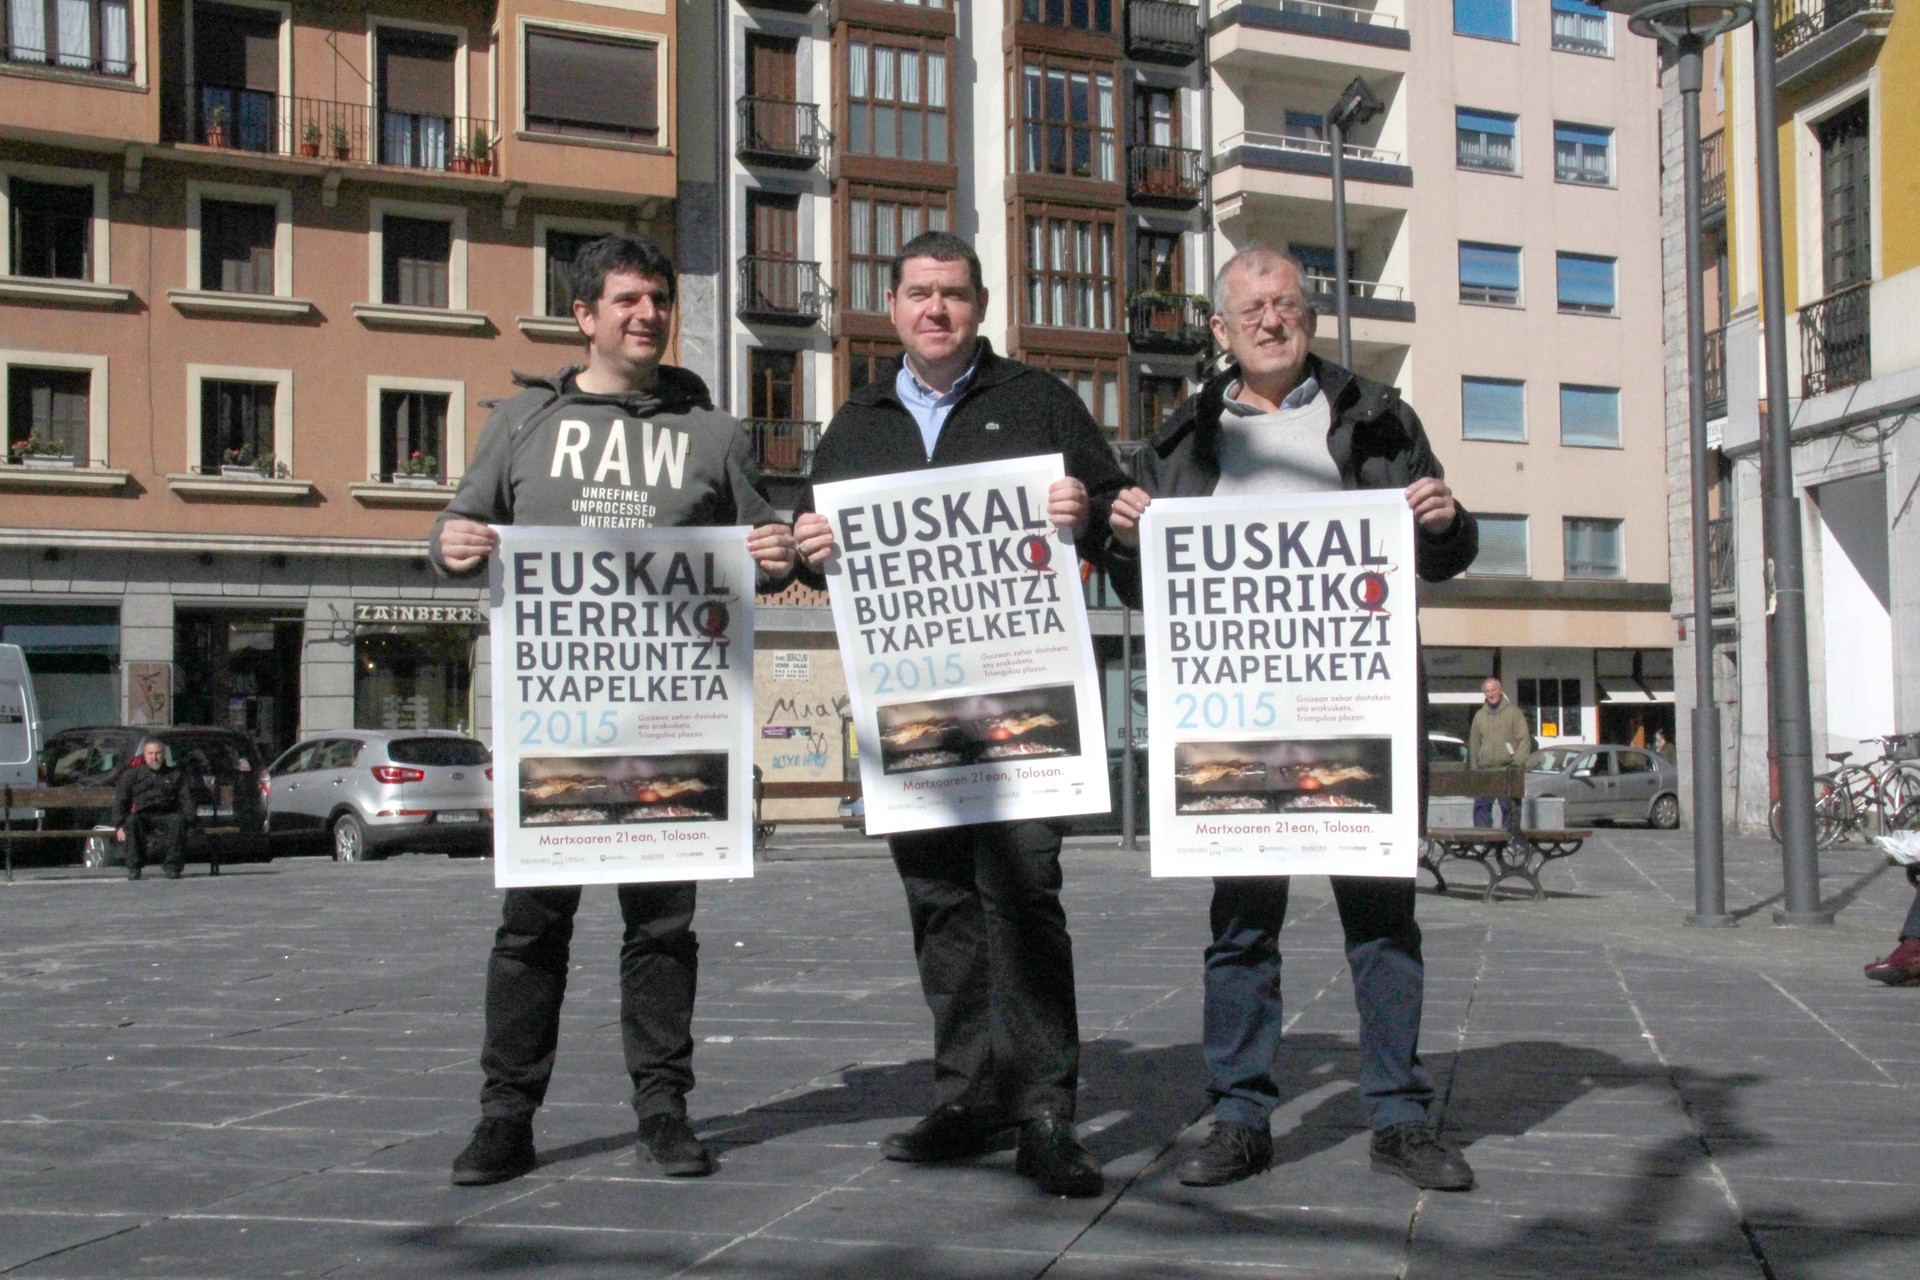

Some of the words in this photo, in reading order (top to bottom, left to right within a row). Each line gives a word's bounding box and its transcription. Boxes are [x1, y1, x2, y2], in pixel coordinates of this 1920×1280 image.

[550, 419, 689, 490] RAW
[572, 499, 656, 517] UNPROCESSED
[582, 487, 648, 502] UNREFINED
[838, 486, 1047, 552] EUSKAL
[1165, 518, 1388, 572] EUSKAL
[514, 551, 730, 596] EUSKAL
[847, 534, 1052, 592] HERRIKO
[855, 574, 1061, 625] BURRUNTZI
[1168, 571, 1389, 615] HERRIKO
[515, 600, 730, 638] HERRIKO
[861, 607, 1065, 655] TXAPELKETA
[1170, 615, 1391, 651] BURRUNTZI
[516, 641, 730, 671] BURRUNTZI
[982, 661, 993, 669] eta
[1013, 648, 1032, 657] zehar
[1172, 651, 1391, 685] TXAPELKETA
[517, 675, 729, 702] TXAPELKETA
[869, 652, 965, 695] 2015
[1174, 691, 1277, 729] 2015
[1296, 695, 1328, 703] Gaizean
[1331, 694, 1352, 702] zehar
[1355, 693, 1391, 701] dastaketa
[519, 710, 619, 745] 2015
[671, 713, 692, 721] zehar
[903, 775, 967, 791] Martxoaren
[971, 771, 1011, 785] 21ean,
[1016, 767, 1065, 779] Tolosan.
[539, 834, 612, 846] Martxoaren
[616, 832, 657, 844] 21ean,
[661, 829, 711, 842] Tolosan.
[1196, 823, 1271, 834] Martxoaren
[1275, 821, 1319, 835] 21ean,
[1323, 821, 1374, 833] Tolosan.
